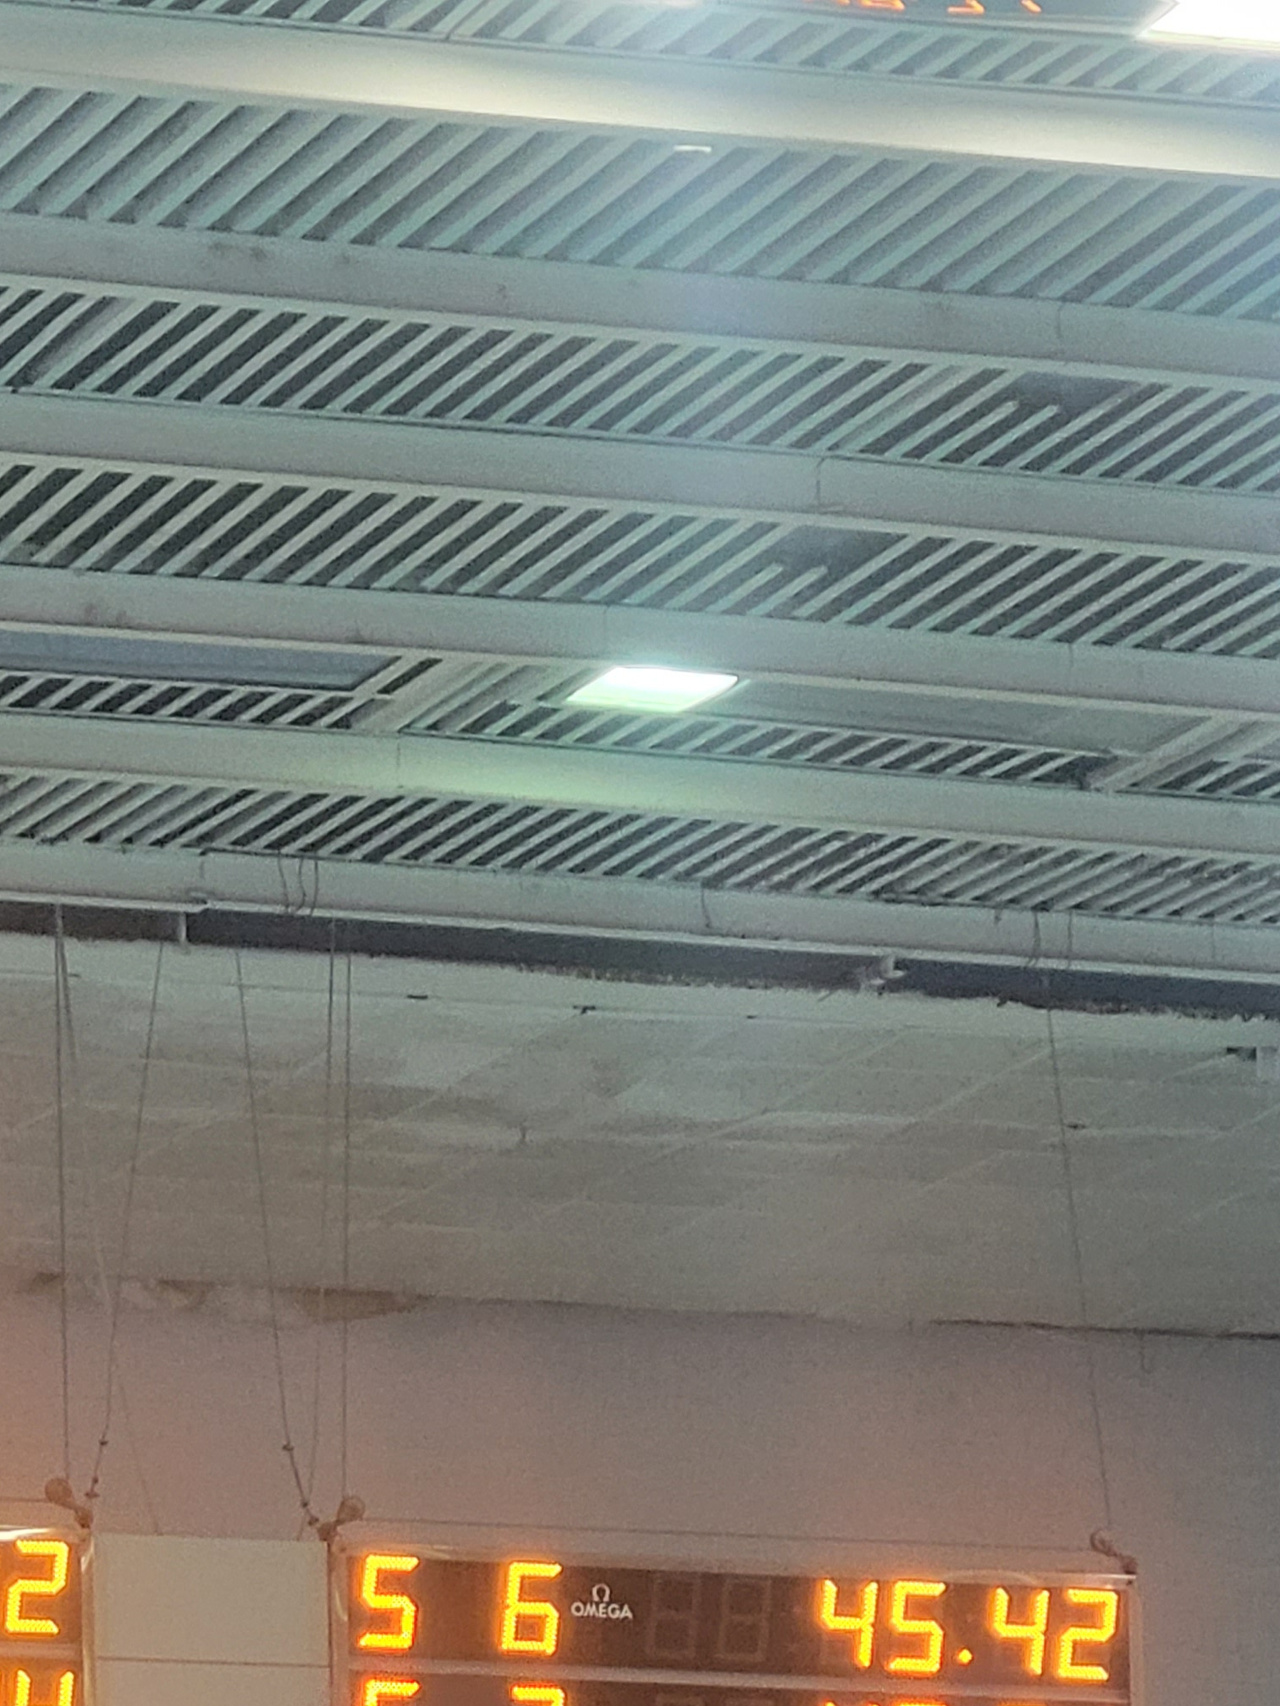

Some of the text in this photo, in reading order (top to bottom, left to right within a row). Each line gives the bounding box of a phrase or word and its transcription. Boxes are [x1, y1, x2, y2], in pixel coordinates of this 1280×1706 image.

[354, 1550, 420, 1653] 5
[496, 1557, 563, 1657] 6
[570, 1601, 633, 1620] OMEGA
[814, 1576, 1119, 1684] 45.42
